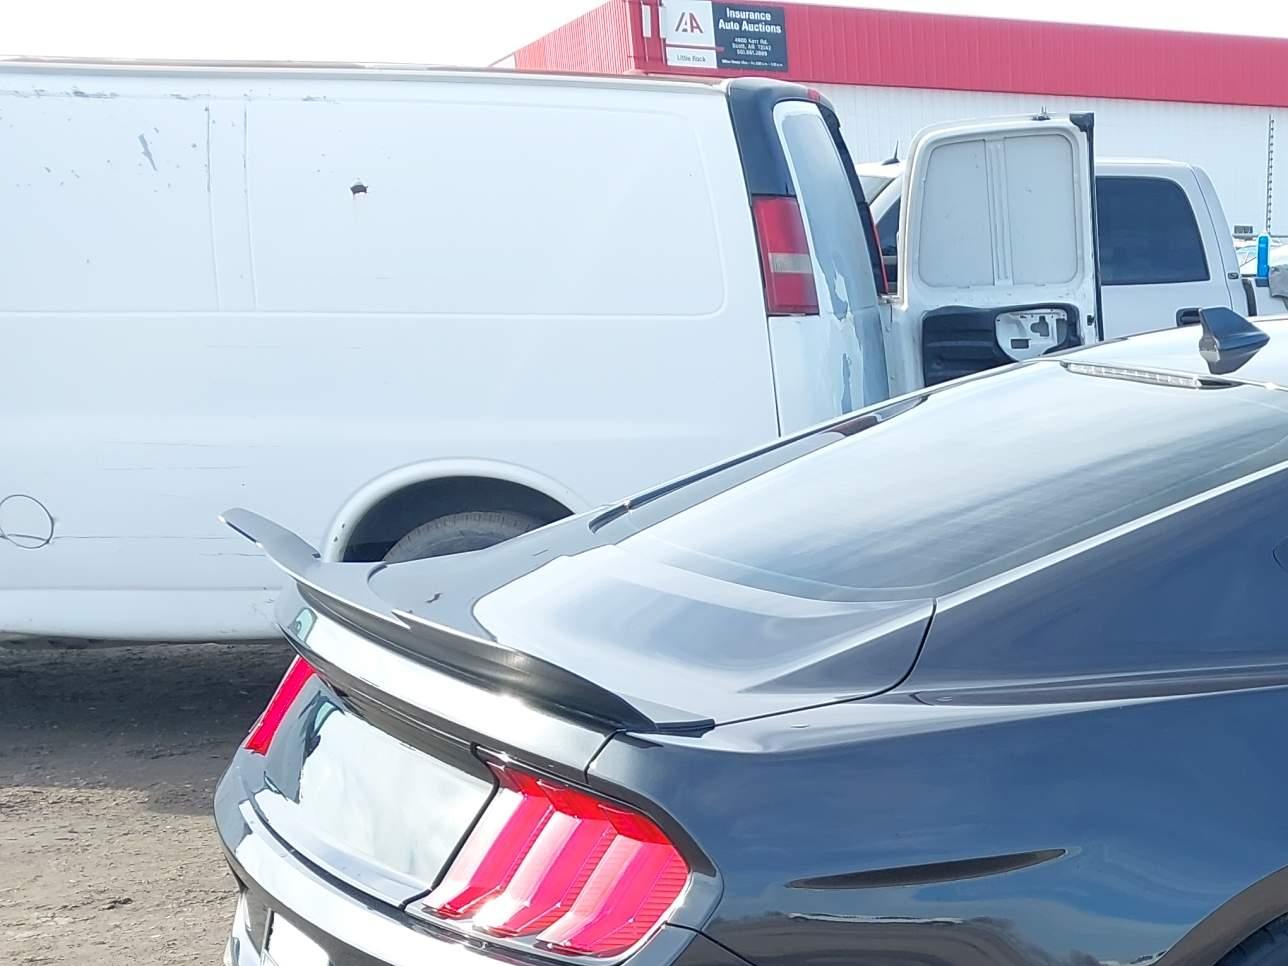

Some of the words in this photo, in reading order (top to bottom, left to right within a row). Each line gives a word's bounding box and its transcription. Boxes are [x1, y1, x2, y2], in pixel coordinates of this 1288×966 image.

[726, 7, 771, 21] Insurance
[718, 19, 739, 31] Auto
[741, 21, 782, 34] Auctions
[677, 54, 691, 62] Little
